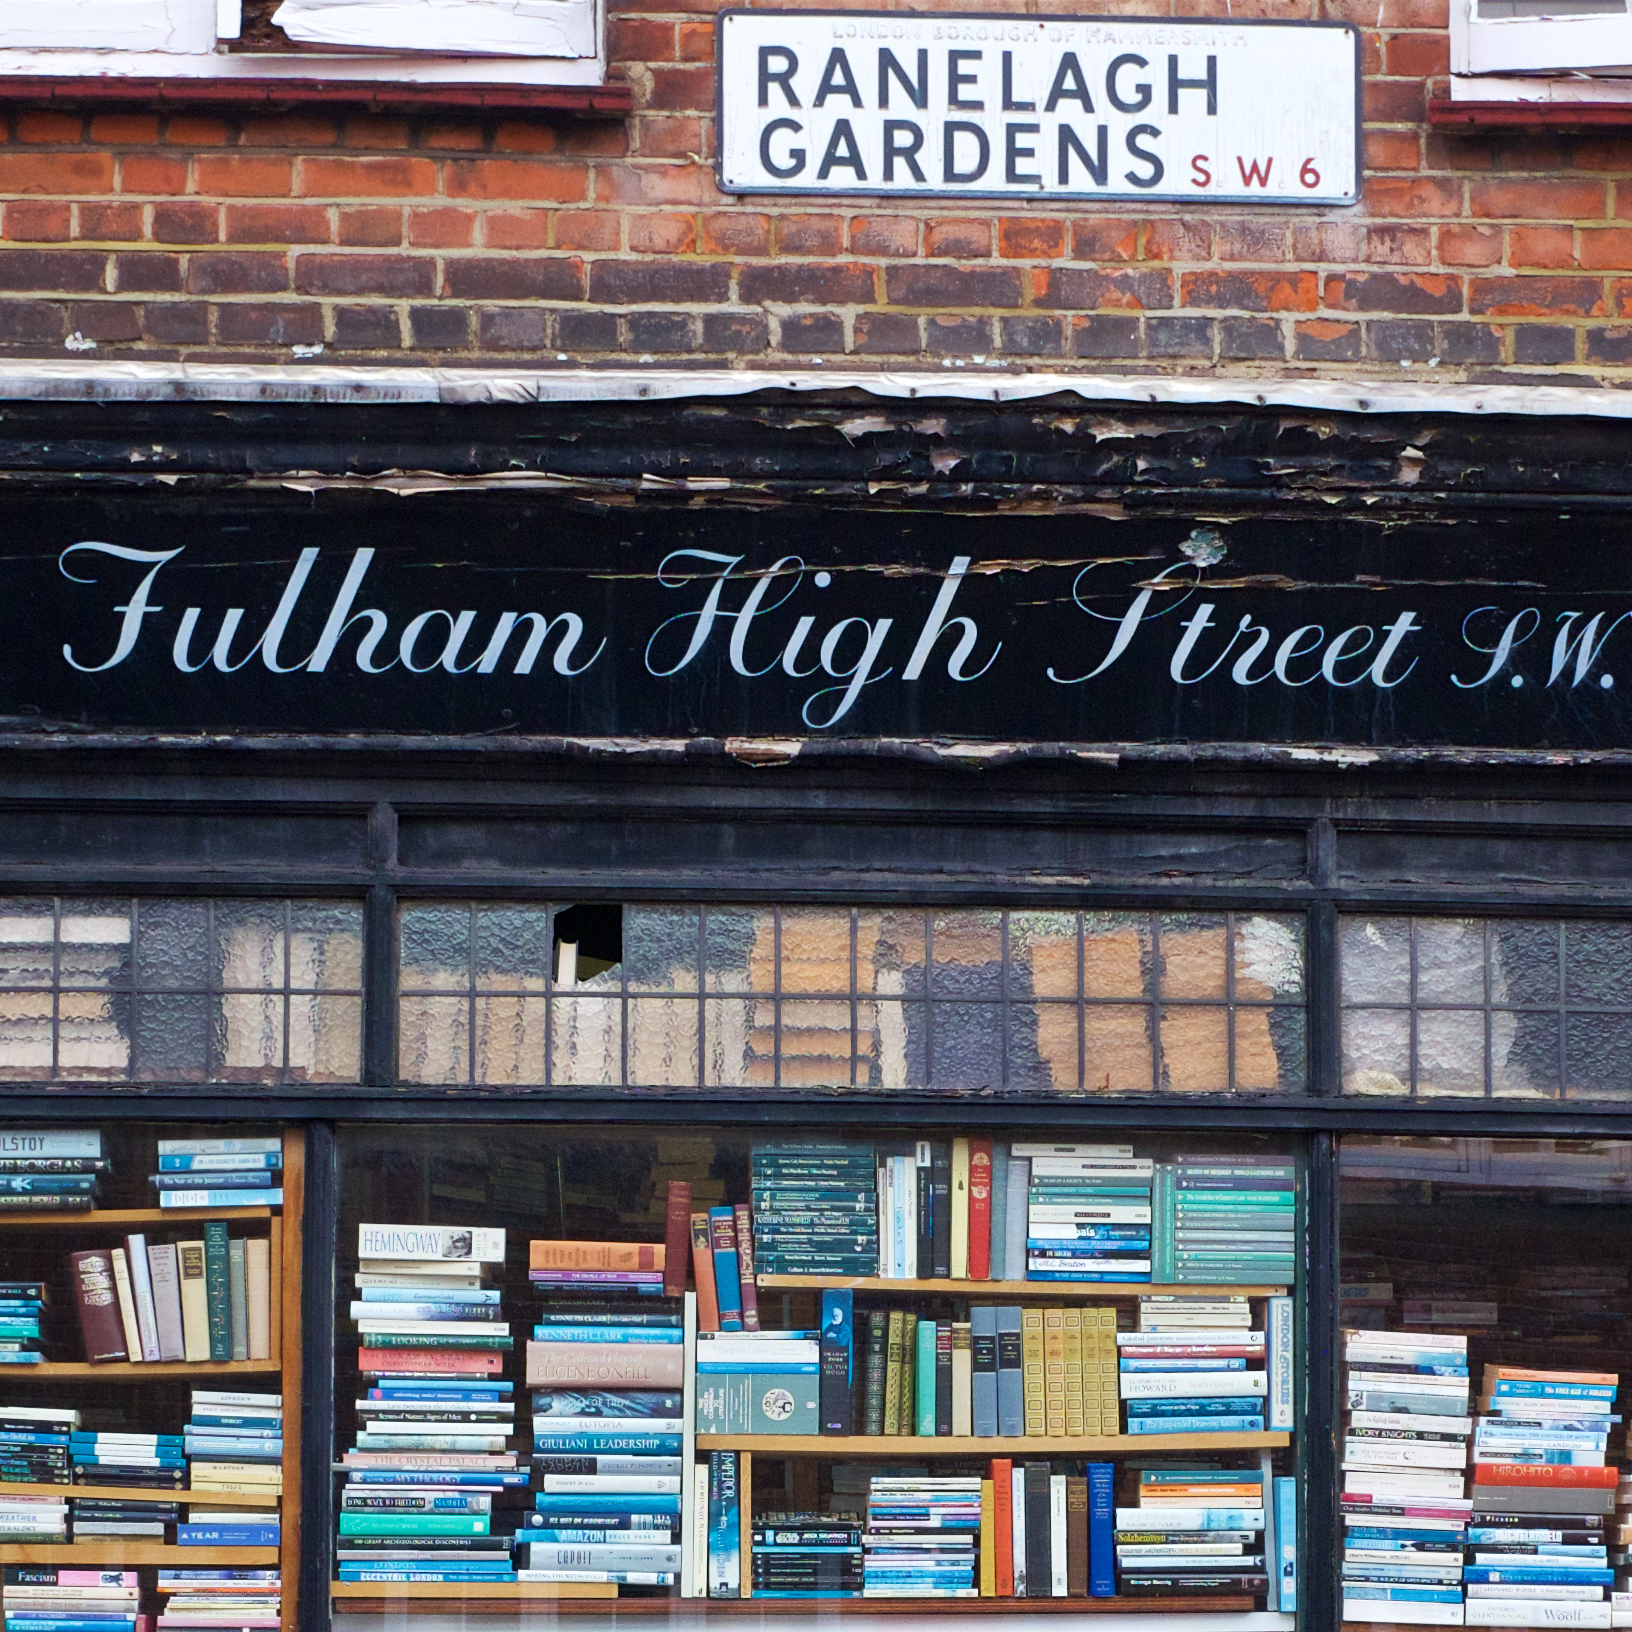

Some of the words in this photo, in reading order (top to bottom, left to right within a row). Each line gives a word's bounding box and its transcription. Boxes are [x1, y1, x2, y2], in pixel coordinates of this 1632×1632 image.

[757, 45, 1218, 115] RANELAGH
[760, 118, 1164, 188] GARDENS
[1299, 159, 1320, 188] 6
[59, 541, 607, 677] Fulham
[644, 549, 1003, 730] High
[1046, 560, 1422, 685] Street
[364, 1230, 442, 1255] HEMINGWAY
[538, 1329, 582, 1341] KENNETH
[585, 1330, 623, 1342] CLARK
[1129, 1382, 1177, 1394] HOWARD
[577, 1419, 623, 1430] EUTOPIA
[1355, 1429, 1379, 1438] IVORY
[1381, 1430, 1417, 1440] KNIGHTS
[539, 1438, 588, 1450] GIULIANI
[593, 1438, 660, 1450] LEADERSHIP
[397, 1455, 443, 1466] CRYSTAL
[445, 1455, 489, 1466] PALACE
[1492, 1465, 1553, 1477] HIROHITO
[394, 1474, 462, 1485] MYTHOLOGY
[561, 1530, 606, 1542] AMAZON
[17, 1570, 57, 1583] Fascism
[406, 1573, 444, 1582] LONDON
[1544, 1607, 1583, 1622] Woolf
